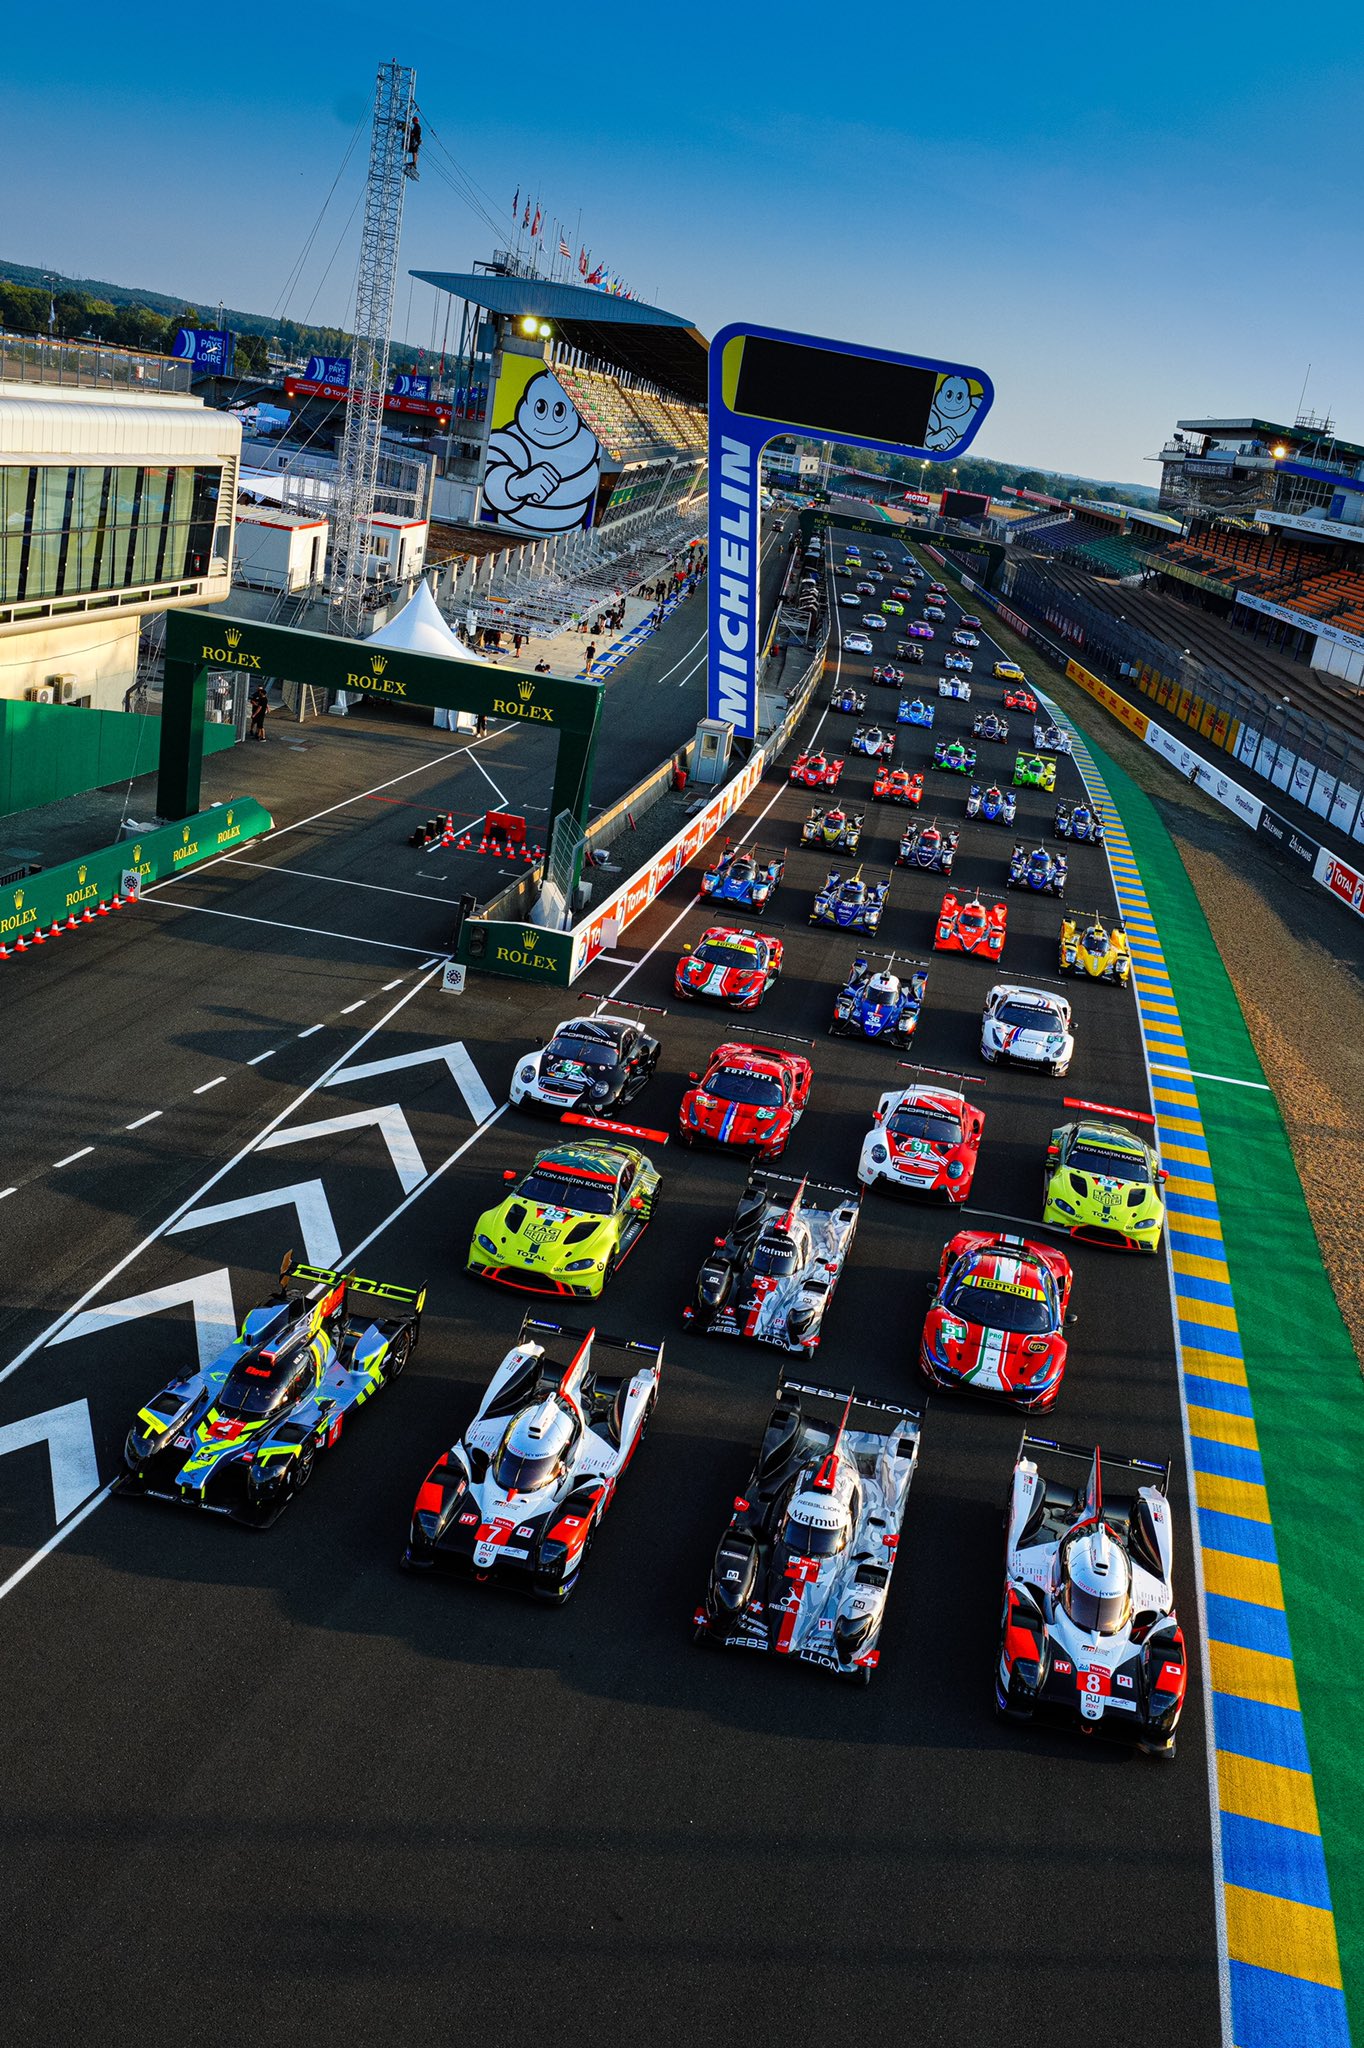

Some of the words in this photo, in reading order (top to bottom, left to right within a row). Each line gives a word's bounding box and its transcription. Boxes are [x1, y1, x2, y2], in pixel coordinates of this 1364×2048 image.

[200, 339, 223, 352] PAYS
[196, 353, 222, 365] LOIRE
[328, 364, 347, 375] PAYS
[323, 375, 346, 385] LOIRE
[904, 492, 930, 504] MOTUL
[814, 517, 835, 528] ROLEX
[851, 525, 873, 535] ROLEX
[891, 532, 912, 542] ROLEX
[929, 539, 951, 550] ROLEX
[970, 546, 991, 557] ROLEX
[717, 434, 752, 729] MICHELIN
[201, 645, 262, 669] ROLEX
[346, 672, 407, 696] ROLEX
[493, 699, 554, 722] ROLEX
[217, 824, 241, 845] ROLEX
[173, 841, 198, 862] ROLEX
[682, 835, 699, 858] TOTAL
[129, 861, 151, 876] OLEX
[656, 861, 675, 882] TOTAL
[1334, 868, 1353, 895] TOTAL
[66, 883, 98, 907] ROLEX
[626, 886, 648, 913] TOTAL
[0, 907, 37, 934] ROLEX
[496, 946, 558, 972] ROLEX
[868, 1015, 880, 1023] 36
[559, 1031, 618, 1048] PORSCHE
[564, 1063, 581, 1073] 92
[724, 1066, 773, 1082] Ferrari
[756, 1108, 775, 1120] 82
[898, 1106, 960, 1123] PORSCHE
[1080, 1100, 1139, 1119] TOTAL
[582, 1115, 648, 1137] TOTAL
[914, 1141, 929, 1152] 91
[1076, 1144, 1098, 1155] ASTON
[1121, 1153, 1145, 1163] RACING
[534, 1169, 557, 1180] ASTON
[557, 1174, 585, 1186] MARTIN
[584, 1180, 613, 1192] RACING
[544, 1207, 565, 1219] 95
[1092, 1210, 1120, 1221] TOTAL
[526, 1230, 557, 1243] HEUER
[531, 1224, 558, 1236] TAG
[496, 1253, 505, 1261] sky
[516, 1248, 548, 1262] TOTAL
[757, 1243, 794, 1258] Matmut
[758, 1280, 770, 1290] 3
[979, 1278, 1032, 1298] Ferrari
[945, 1323, 964, 1338] 51
[989, 1332, 1003, 1340] PRO
[1030, 1343, 1046, 1353] ups
[783, 1381, 921, 1418] REBELLION
[508, 1443, 524, 1456] TOYOTA
[796, 1499, 841, 1513] REBELLION
[461, 1514, 477, 1524] HY
[494, 1518, 513, 1528] TOTAL
[791, 1508, 839, 1527] Matmut
[486, 1525, 502, 1543] 7
[520, 1527, 532, 1536] P1
[800, 1565, 809, 1580] 1
[1077, 1580, 1097, 1595] TOYOTA
[819, 1620, 832, 1630] P1
[1055, 1663, 1070, 1672] HY
[1091, 1665, 1111, 1676] TOTAL
[1086, 1673, 1101, 1693] 8
[1119, 1676, 1131, 1686] P1
